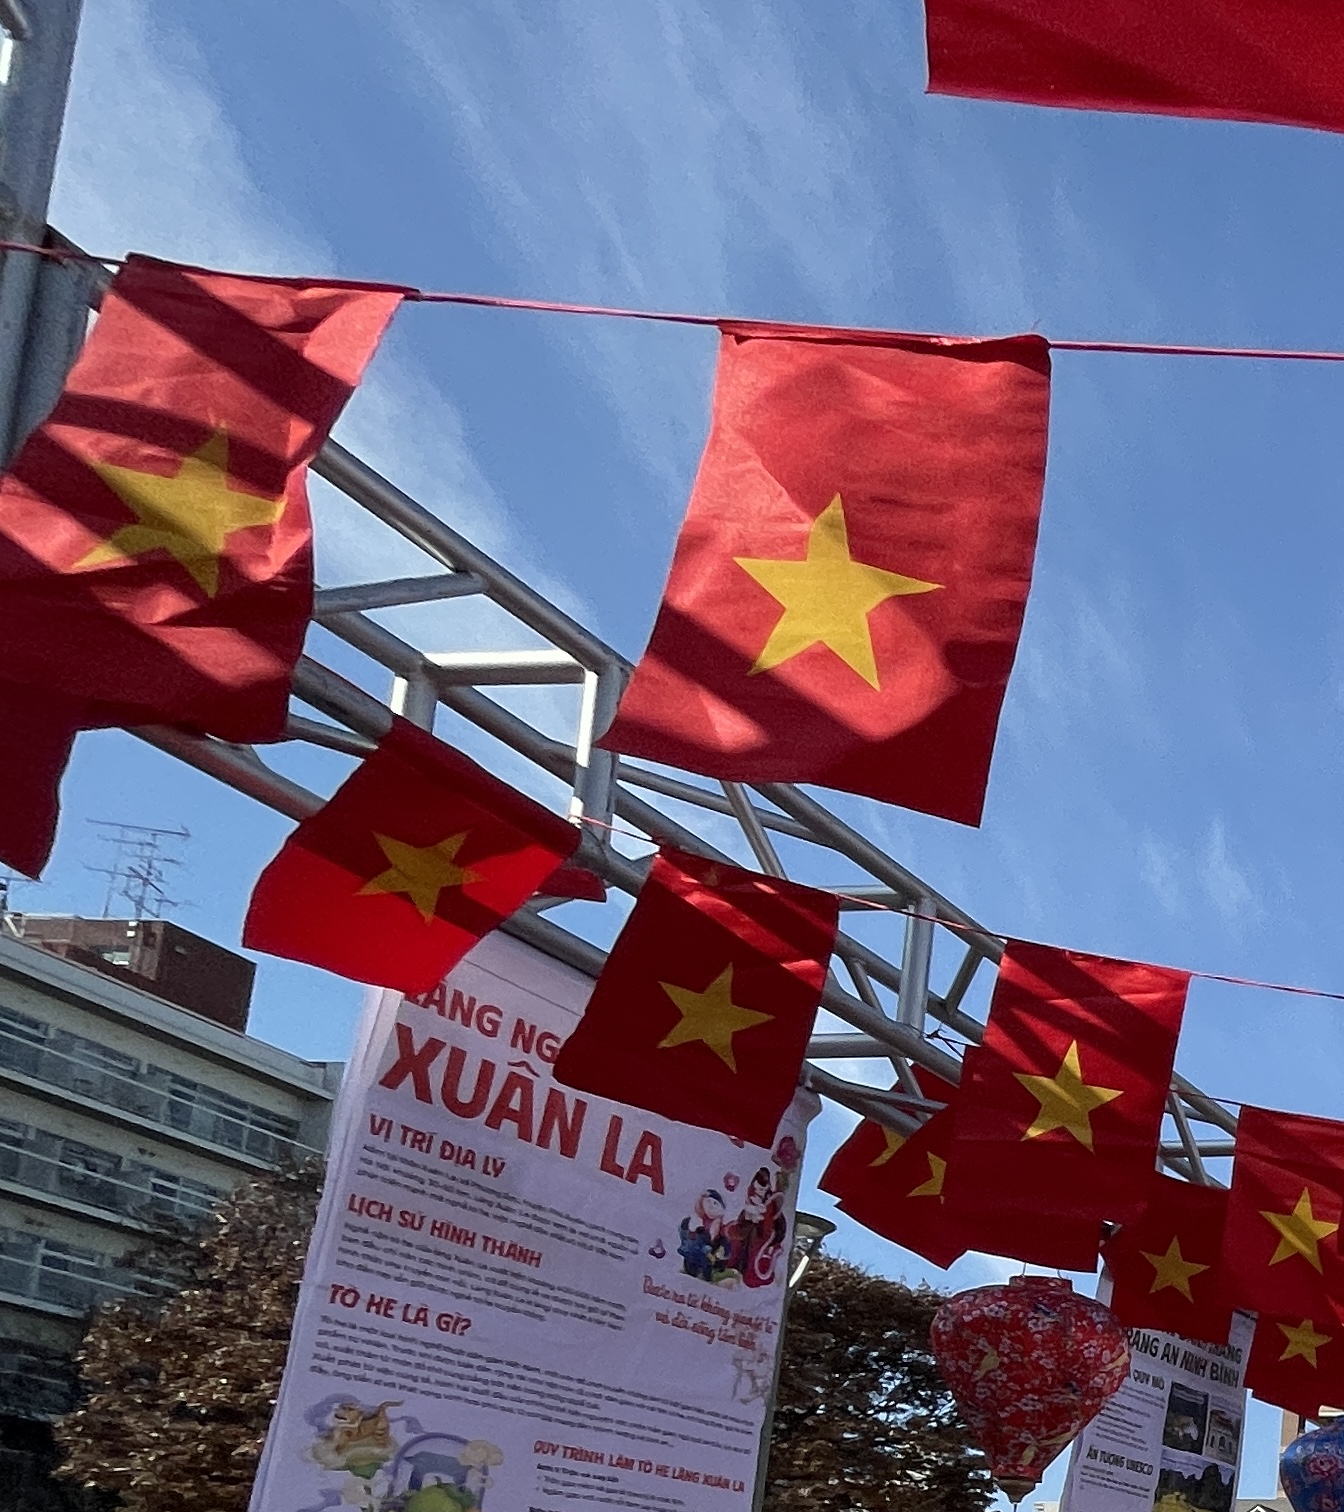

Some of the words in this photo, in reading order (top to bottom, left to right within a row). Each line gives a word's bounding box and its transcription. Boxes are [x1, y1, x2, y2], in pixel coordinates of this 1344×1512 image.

[369, 1113, 393, 1143] VỊ
[400, 1124, 437, 1154] TRÍ
[378, 1023, 587, 1159] XUÂN
[600, 1114, 664, 1195] LA
[349, 1194, 393, 1223] LỊCH
[429, 1219, 477, 1248] HÌNH
[482, 1234, 543, 1268] THÀNH
[328, 1283, 361, 1309] TÒ
[366, 1293, 398, 1320] HE
[401, 1303, 430, 1328] LÀ
[435, 1311, 473, 1337] GÌ?
